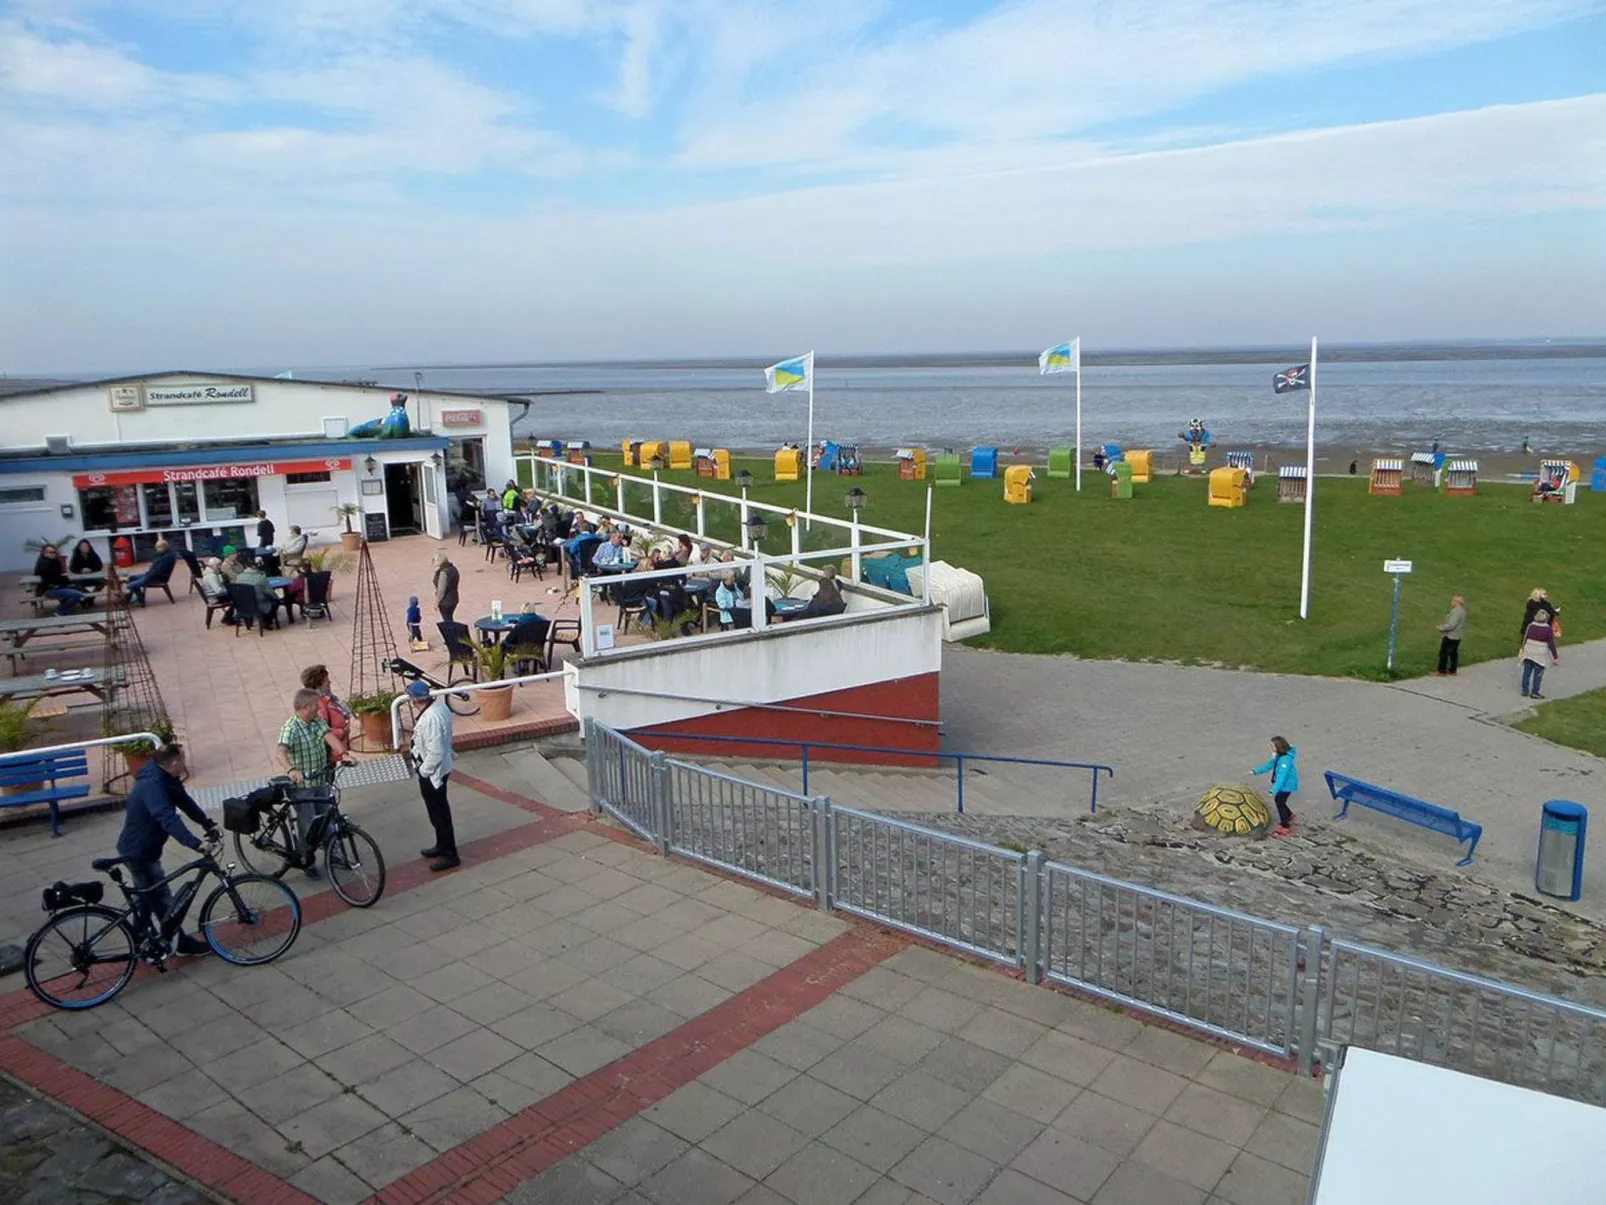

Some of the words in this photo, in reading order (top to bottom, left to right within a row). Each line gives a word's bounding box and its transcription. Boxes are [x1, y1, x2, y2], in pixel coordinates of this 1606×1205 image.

[150, 391, 202, 400] Strandcafé
[204, 387, 249, 398] Rondell
[163, 466, 227, 481] Strandcafé
[230, 464, 275, 477] Rondell
